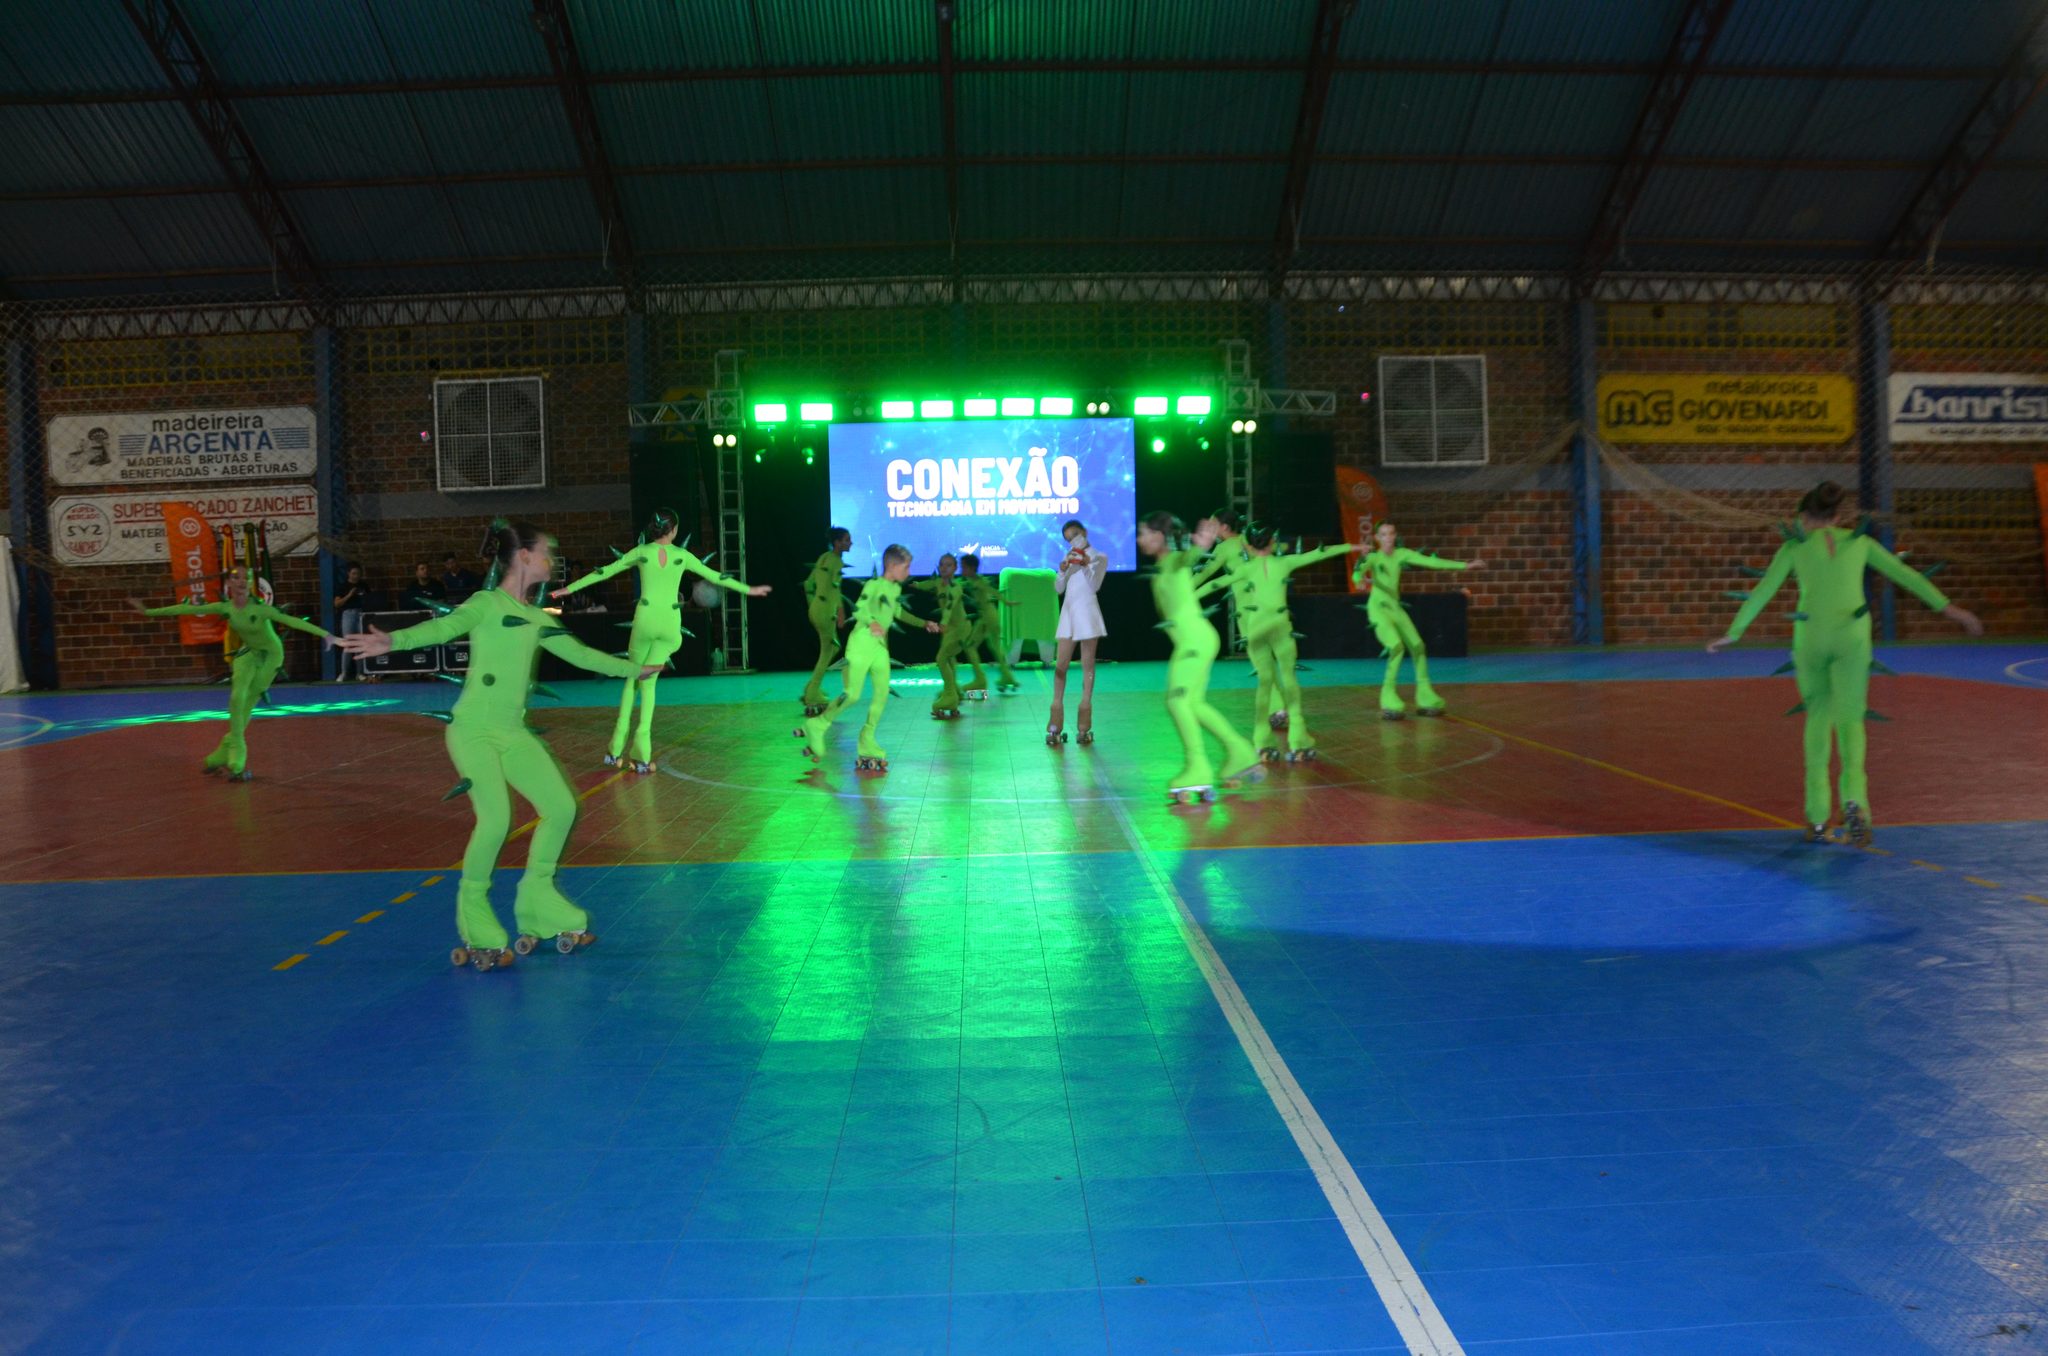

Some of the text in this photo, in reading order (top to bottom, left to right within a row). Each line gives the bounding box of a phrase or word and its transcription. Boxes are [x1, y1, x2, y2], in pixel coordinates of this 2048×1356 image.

[1679, 399, 1829, 420] GIOVENARDI
[1900, 385, 2048, 420] banris
[152, 413, 264, 433] madeireira
[149, 430, 273, 455] ARGENTA
[121, 462, 298, 479] BENEFICIADAS ABERTURAS
[127, 453, 262, 467] MADEIRAS BRUTAS E
[886, 446, 1080, 501] CONEXÃO
[242, 495, 315, 513] ZANCHET
[887, 497, 1080, 518] TECNOLOGIA EM MOVIMENTO
